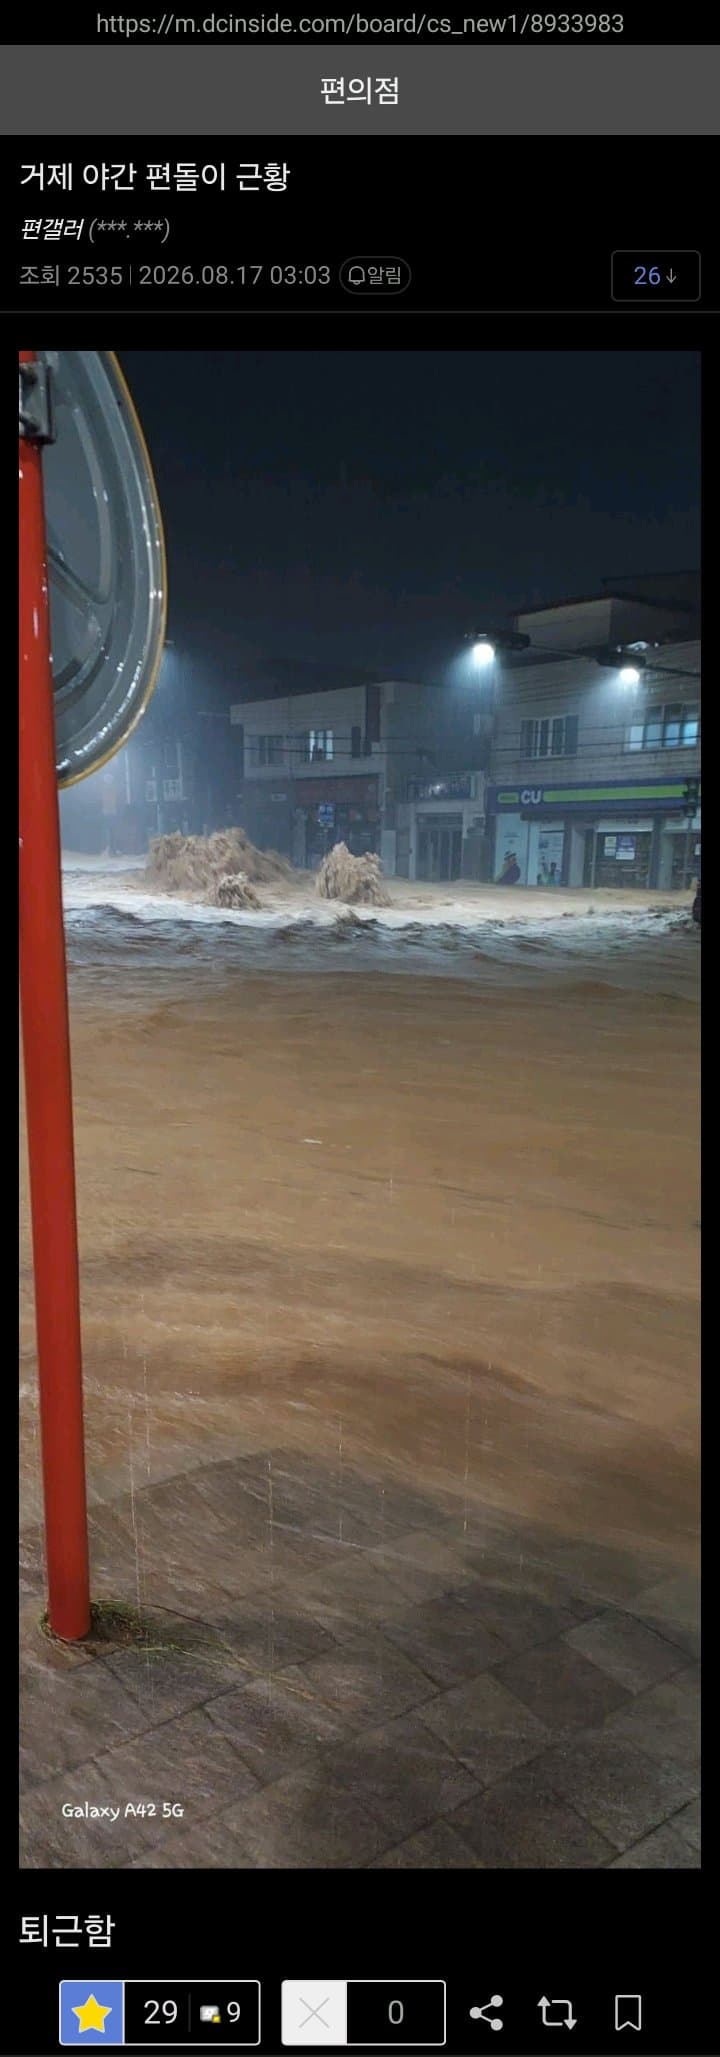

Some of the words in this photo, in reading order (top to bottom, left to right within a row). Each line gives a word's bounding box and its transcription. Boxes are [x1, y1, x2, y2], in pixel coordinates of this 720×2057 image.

[97, 13, 624, 38] https://m.dcinside.com/board/cs_new1/8933983
[320, 77, 399, 105] 편의점
[20, 162, 73, 191] 거제
[82, 162, 138, 191] 야간
[145, 162, 225, 191] 편돌이
[235, 162, 291, 192] 근황
[21, 218, 85, 241] 편갤러
[19, 264, 60, 287] 조회
[67, 266, 123, 285] 2535
[139, 265, 263, 285] 2026.08.17
[270, 265, 331, 285] 03:03
[367, 266, 401, 286] 알림
[634, 265, 661, 286] 26
[520, 790, 542, 804] CU
[18, 1914, 116, 1948] 퇴근함
[143, 1999, 178, 2025] 29
[226, 2001, 241, 2023] 9
[388, 1999, 404, 2025] 0
